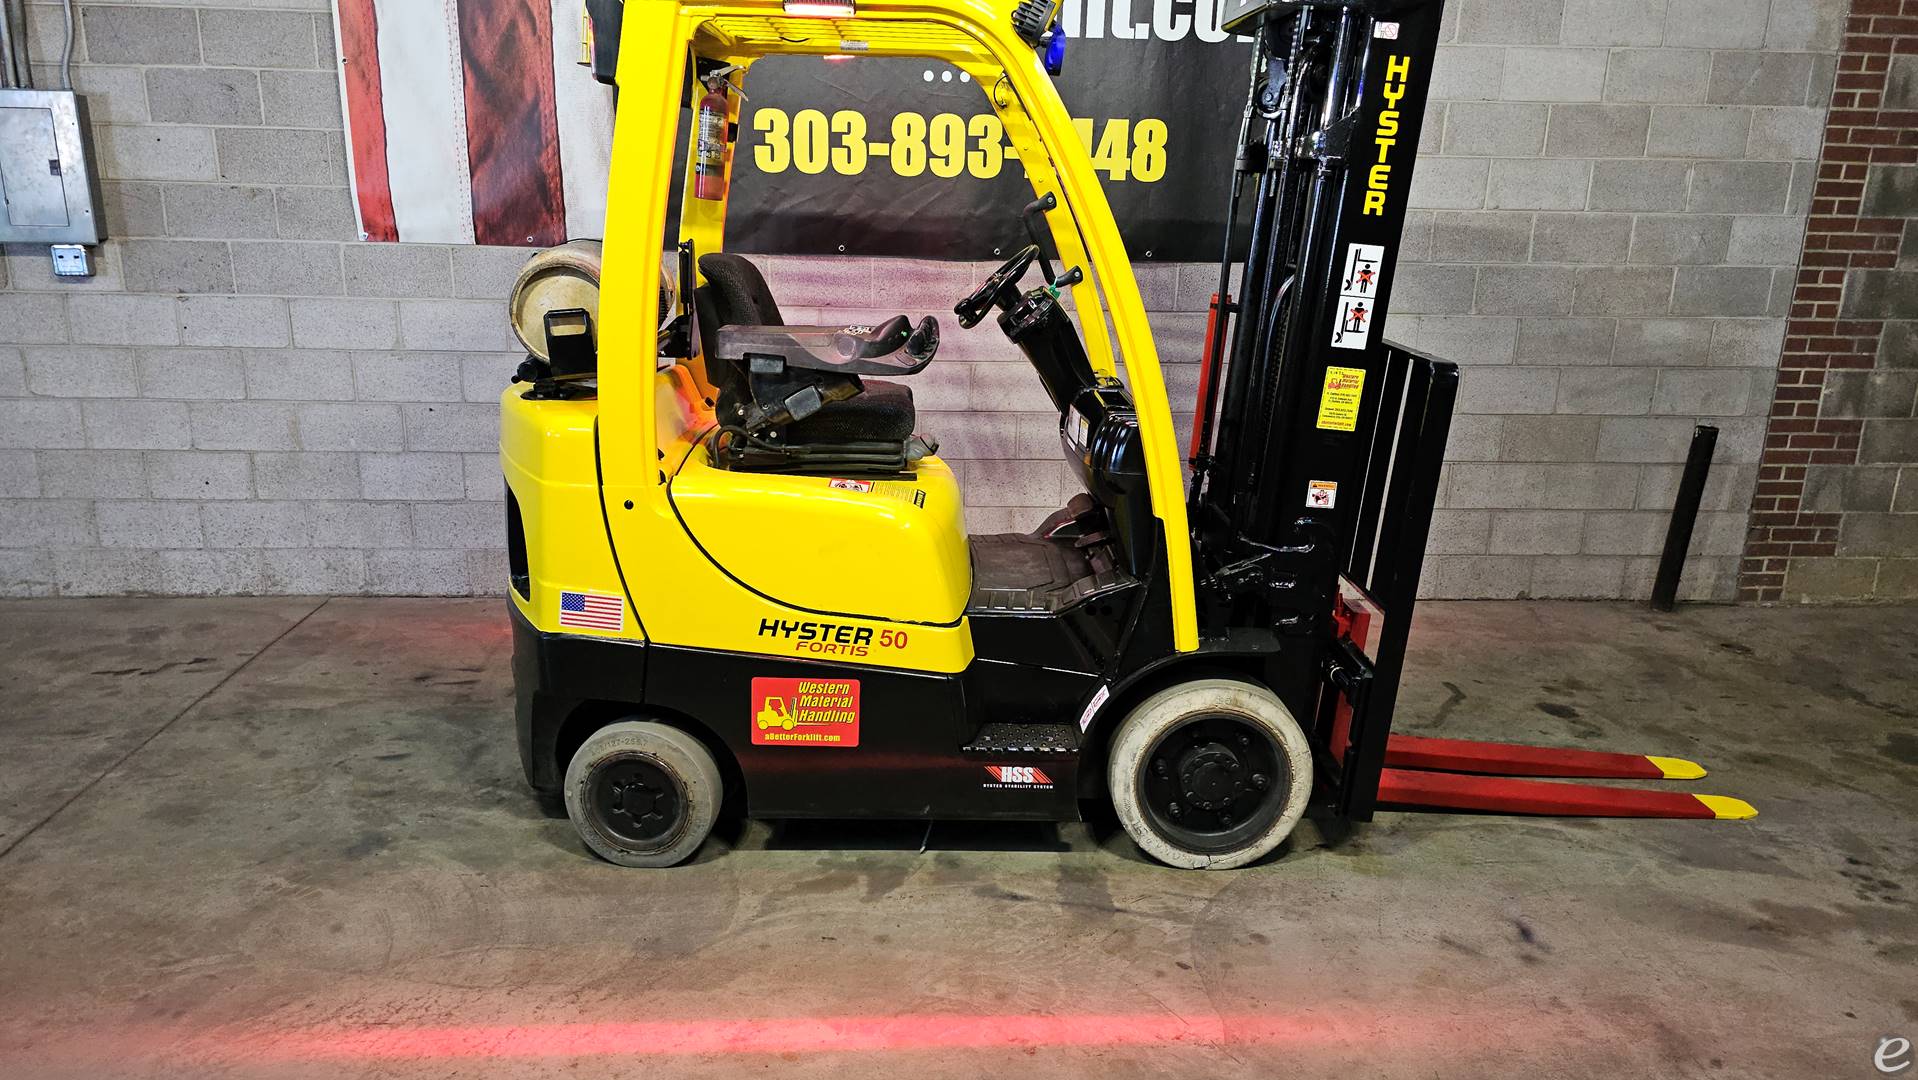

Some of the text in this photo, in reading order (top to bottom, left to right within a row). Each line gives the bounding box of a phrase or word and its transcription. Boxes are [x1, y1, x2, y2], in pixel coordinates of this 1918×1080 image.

[1363, 55, 1411, 216] HYSTER
[753, 108, 1168, 183] 303-893-48
[758, 618, 908, 649] HYSTER 50
[795, 641, 869, 657] FORTIS
[798, 681, 850, 695] Western
[799, 695, 854, 708] Material
[798, 709, 856, 724] Handling
[1000, 766, 1034, 784] HSS
